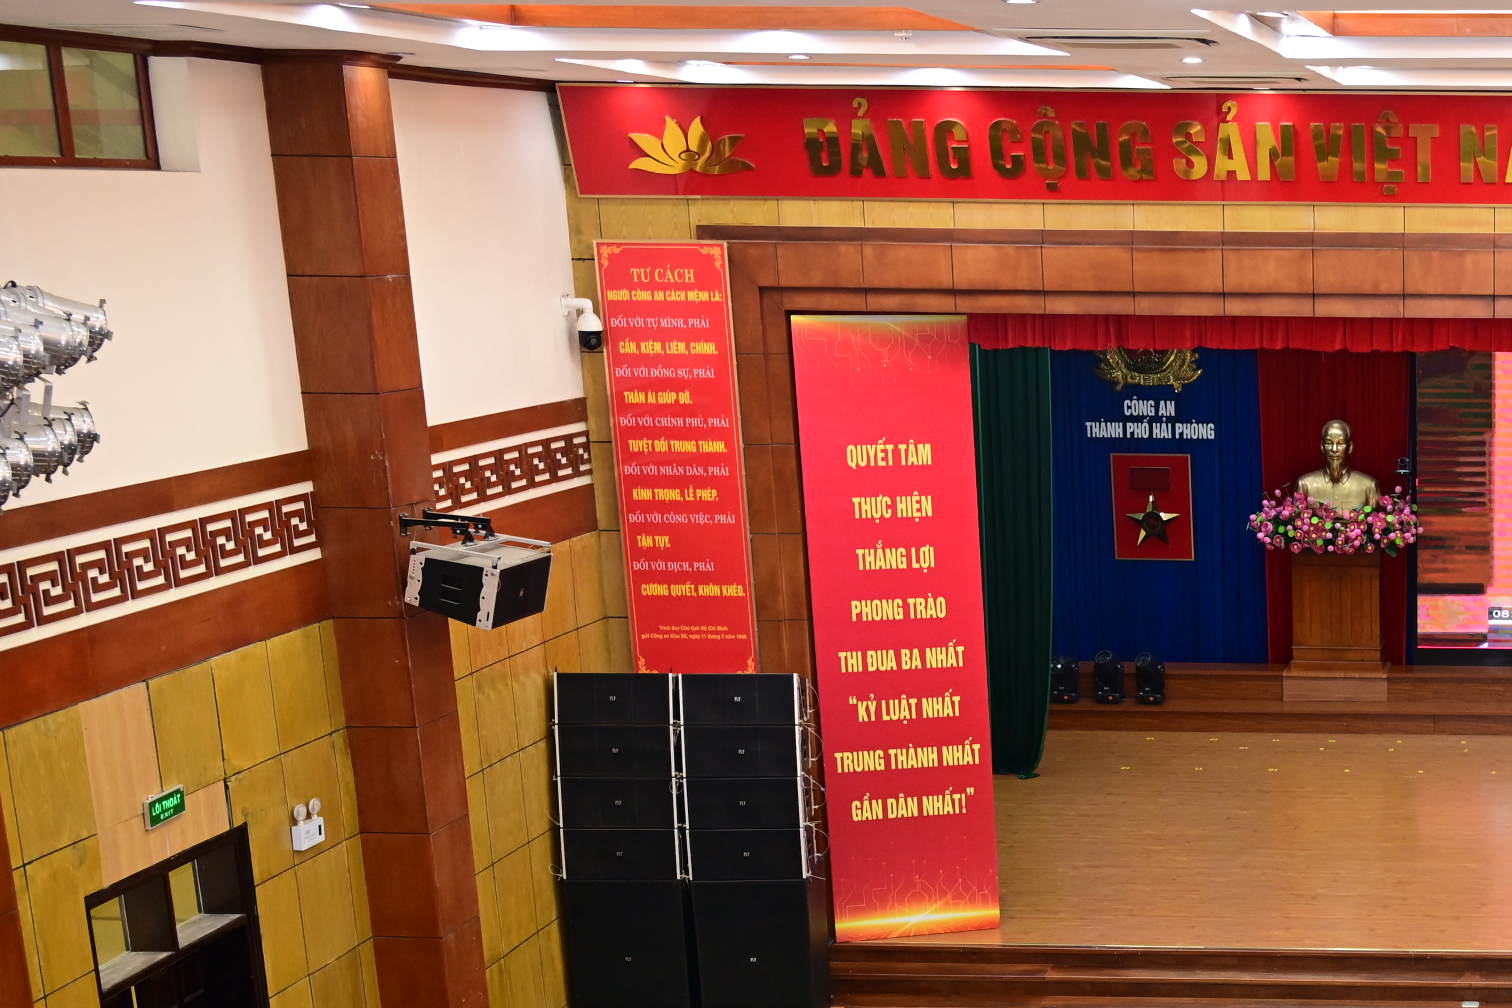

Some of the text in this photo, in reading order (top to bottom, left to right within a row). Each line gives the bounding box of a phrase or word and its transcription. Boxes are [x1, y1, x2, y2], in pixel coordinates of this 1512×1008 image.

[804, 97, 972, 178] ĐẢNG
[990, 106, 1155, 192] CỘNG
[1172, 101, 1296, 182] SẢN
[1311, 110, 1440, 196] VIỆT
[631, 265, 695, 282] TƯ CÁCH
[632, 290, 651, 300] CÔNG
[654, 292, 664, 301] AN
[666, 289, 685, 301] CÁCH
[711, 290, 722, 301] LÀ:
[611, 315, 709, 330] ĐỐI VỚI TỰ MÌNH, PHẢI
[641, 339, 664, 356] KIỆM,
[666, 340, 688, 355] LIÊM,
[691, 341, 718, 354] CHÍNH.
[616, 364, 631, 377] ĐỐI
[633, 367, 649, 377] VỚI
[678, 368, 691, 380] SỰ,
[694, 365, 714, 378] PHẢI
[1124, 396, 1175, 417] CÔNG AN
[620, 414, 729, 428] ĐỐI VỚI CHÍNH PHỦ, PHẢI
[1086, 417, 1214, 439] THÀNH PHỐ HẢI PHÒNG
[628, 436, 727, 454] TUYỆT ĐỐI TRUNG THÀNH.
[847, 437, 932, 469] QUYẾT TÂM
[624, 462, 728, 477] ĐỐI VỚI NHÂN DÂN, PHẢI
[852, 491, 932, 523] THỰC HIỆN
[629, 511, 735, 525] ĐỐI VỚI CÔNG VIỆC, PHẢI
[637, 534, 653, 549] TẬN
[633, 559, 714, 572] ĐỐI VỚI ĐỊCH, PHẢI
[856, 540, 934, 573] THẮNG LỢI
[852, 592, 946, 621] PHONG TRÀO
[839, 639, 964, 673] THI ĐUA BA NHẤT
[882, 695, 917, 724] LUẬT
[922, 689, 960, 718] NHẤT
[835, 737, 980, 773] TRUNG THÀNH NHẤT
[161, 809, 174, 819] EXIT
[852, 793, 883, 821] GẦN
[888, 794, 918, 819] DÂN
